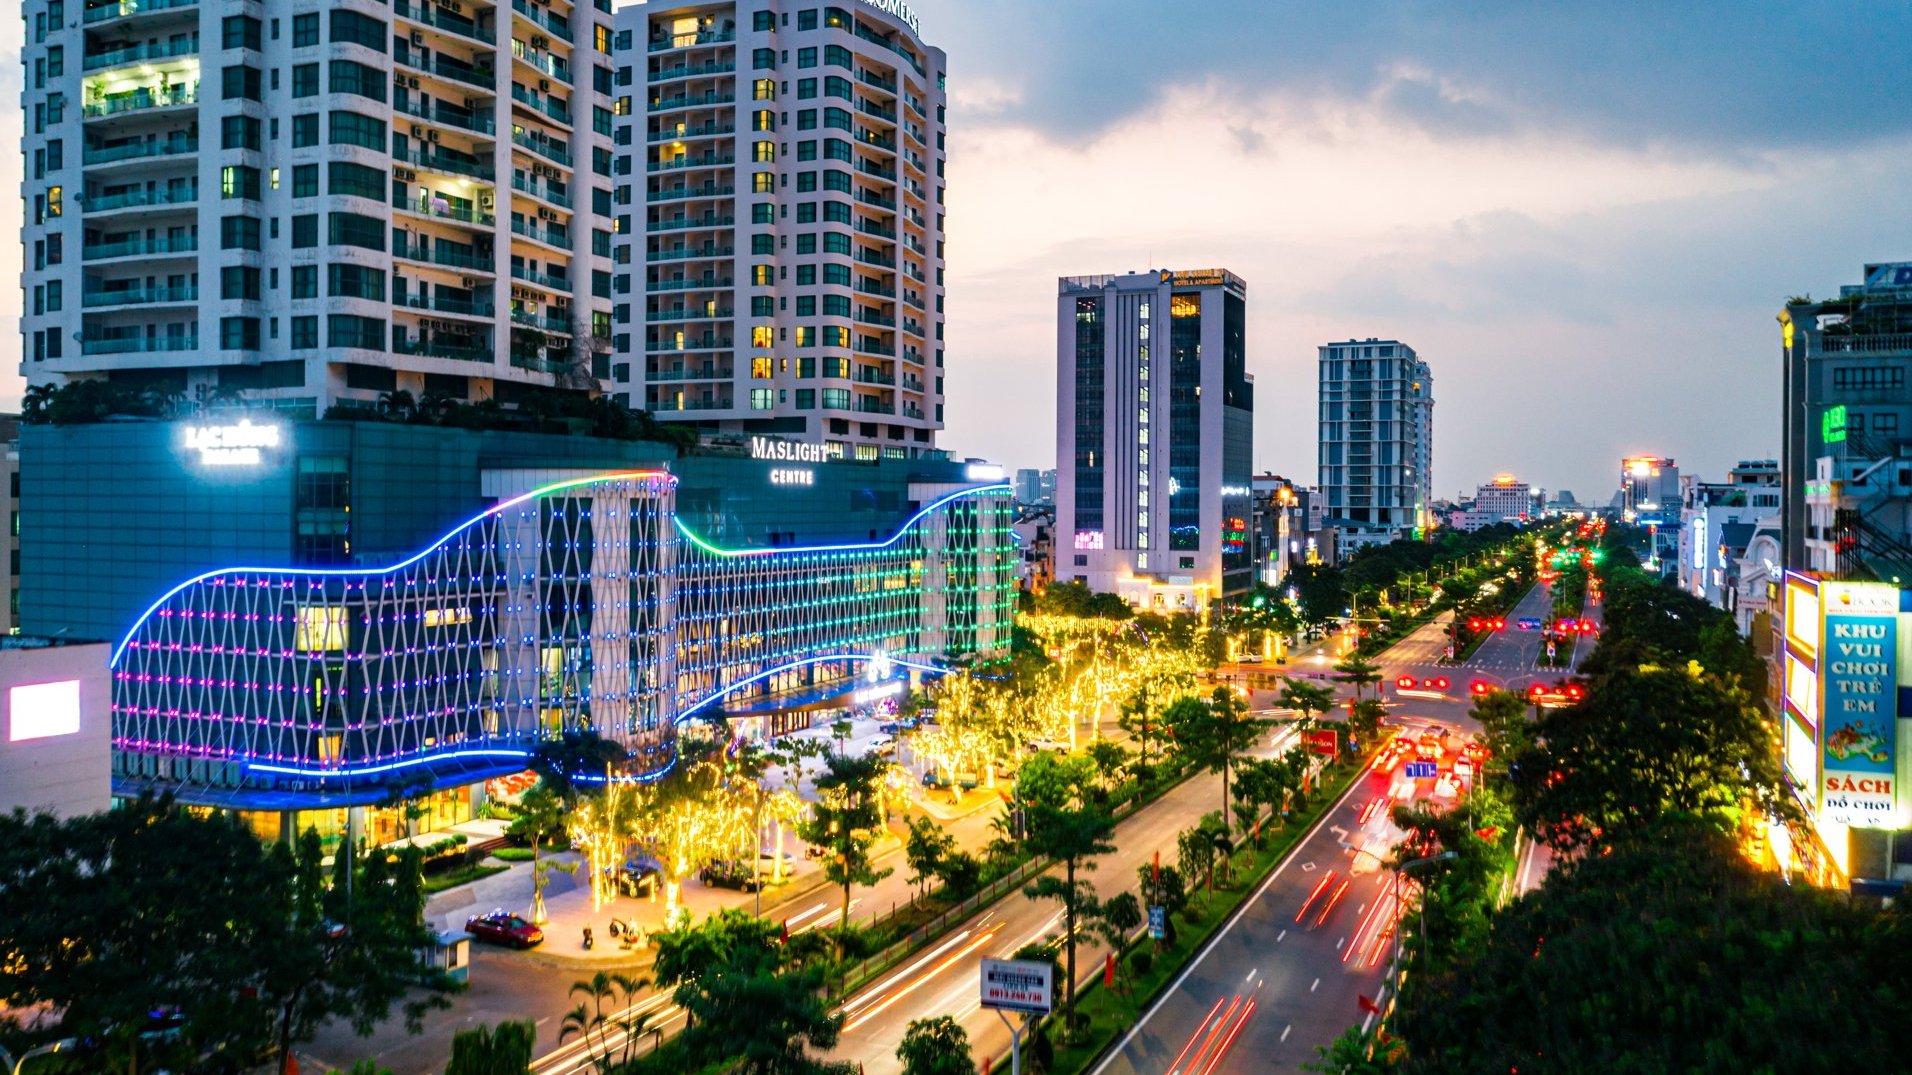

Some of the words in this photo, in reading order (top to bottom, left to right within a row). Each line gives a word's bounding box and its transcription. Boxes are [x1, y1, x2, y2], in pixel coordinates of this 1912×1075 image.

[752, 436, 827, 462] MASLIGHT
[770, 469, 814, 484] CENTRE
[1834, 624, 1886, 639] KHU
[1839, 643, 1882, 658] VUI
[1831, 660, 1889, 676] CHƠI
[1843, 699, 1876, 713] EM
[1826, 774, 1892, 794] SÁCH
